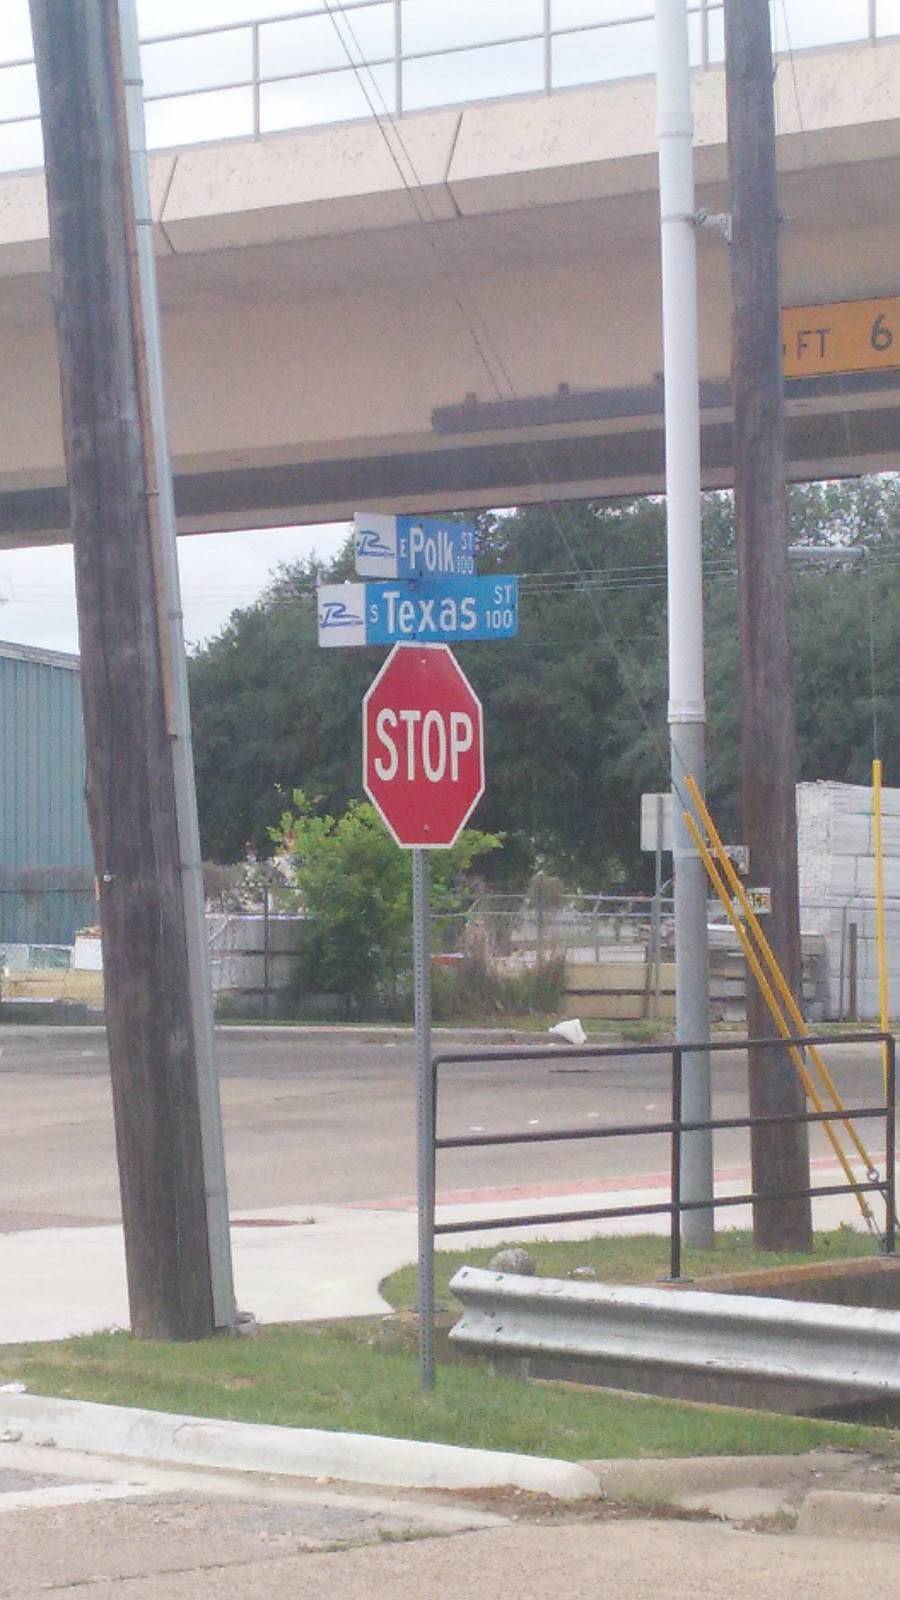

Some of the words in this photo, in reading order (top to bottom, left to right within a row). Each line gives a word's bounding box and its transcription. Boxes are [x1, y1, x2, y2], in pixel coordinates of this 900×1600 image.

[796, 328, 830, 359] FT
[871, 313, 893, 352] 6
[409, 527, 455, 573] Polk
[461, 532, 474, 551] ST
[457, 556, 474, 574] 100
[369, 604, 379, 624] S
[382, 591, 478, 635] Texas
[494, 585, 513, 605] ST
[486, 610, 513, 629] 100
[374, 707, 474, 783] STOP
